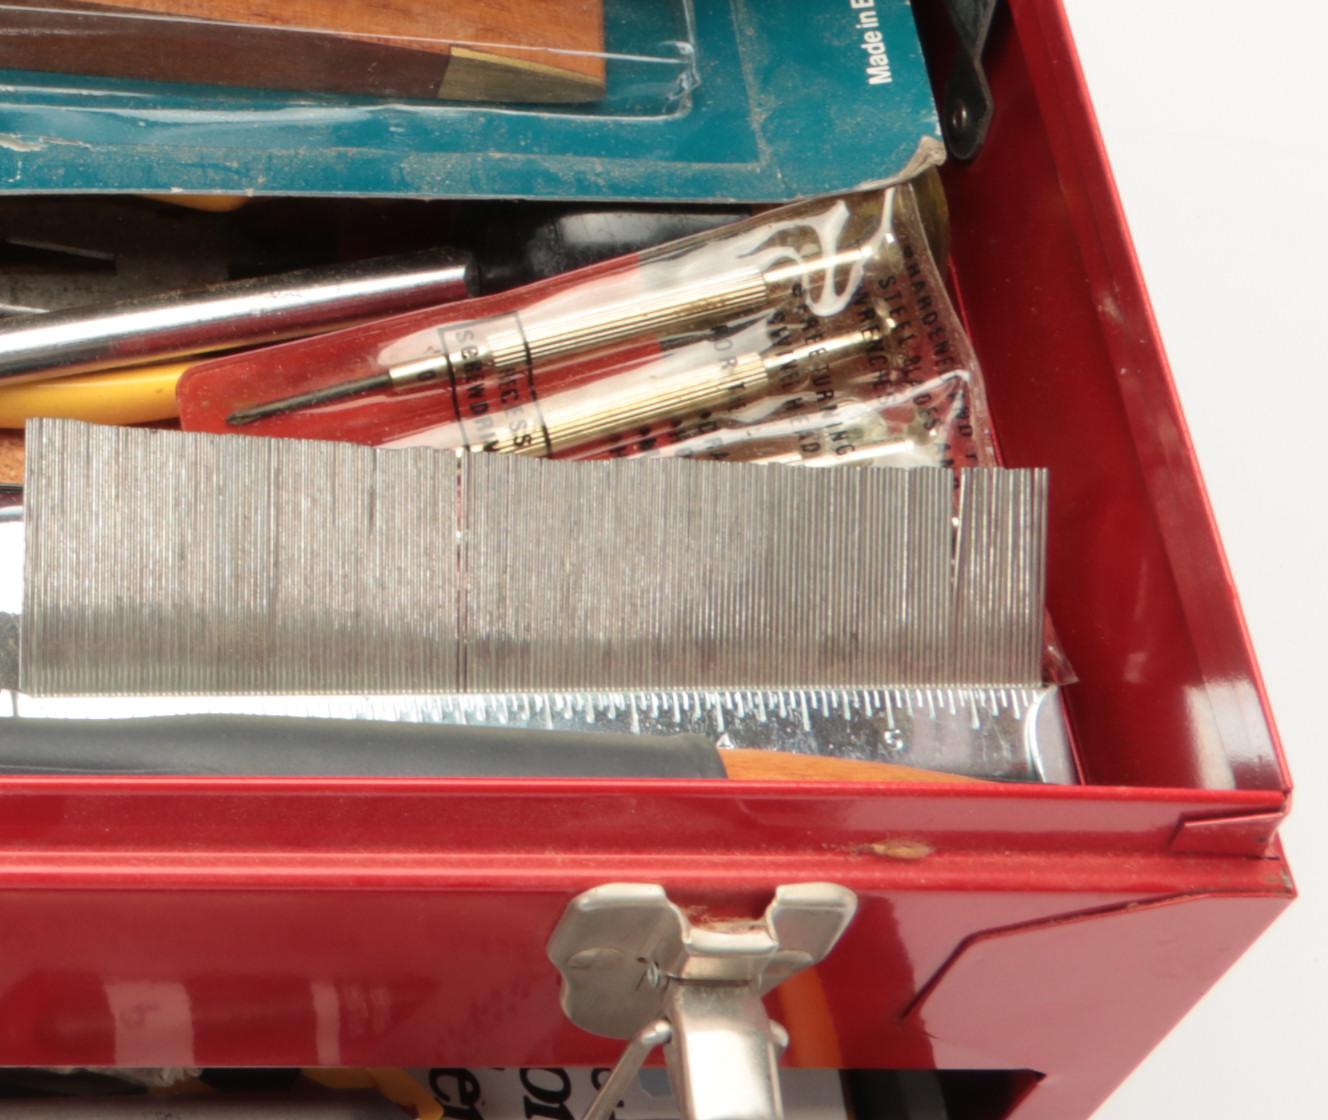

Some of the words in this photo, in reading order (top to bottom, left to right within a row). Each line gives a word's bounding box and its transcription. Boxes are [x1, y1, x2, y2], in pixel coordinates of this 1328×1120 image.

[855, 10, 880, 29] in
[860, 30, 893, 85] Made
[878, 275, 916, 344] STEEL
